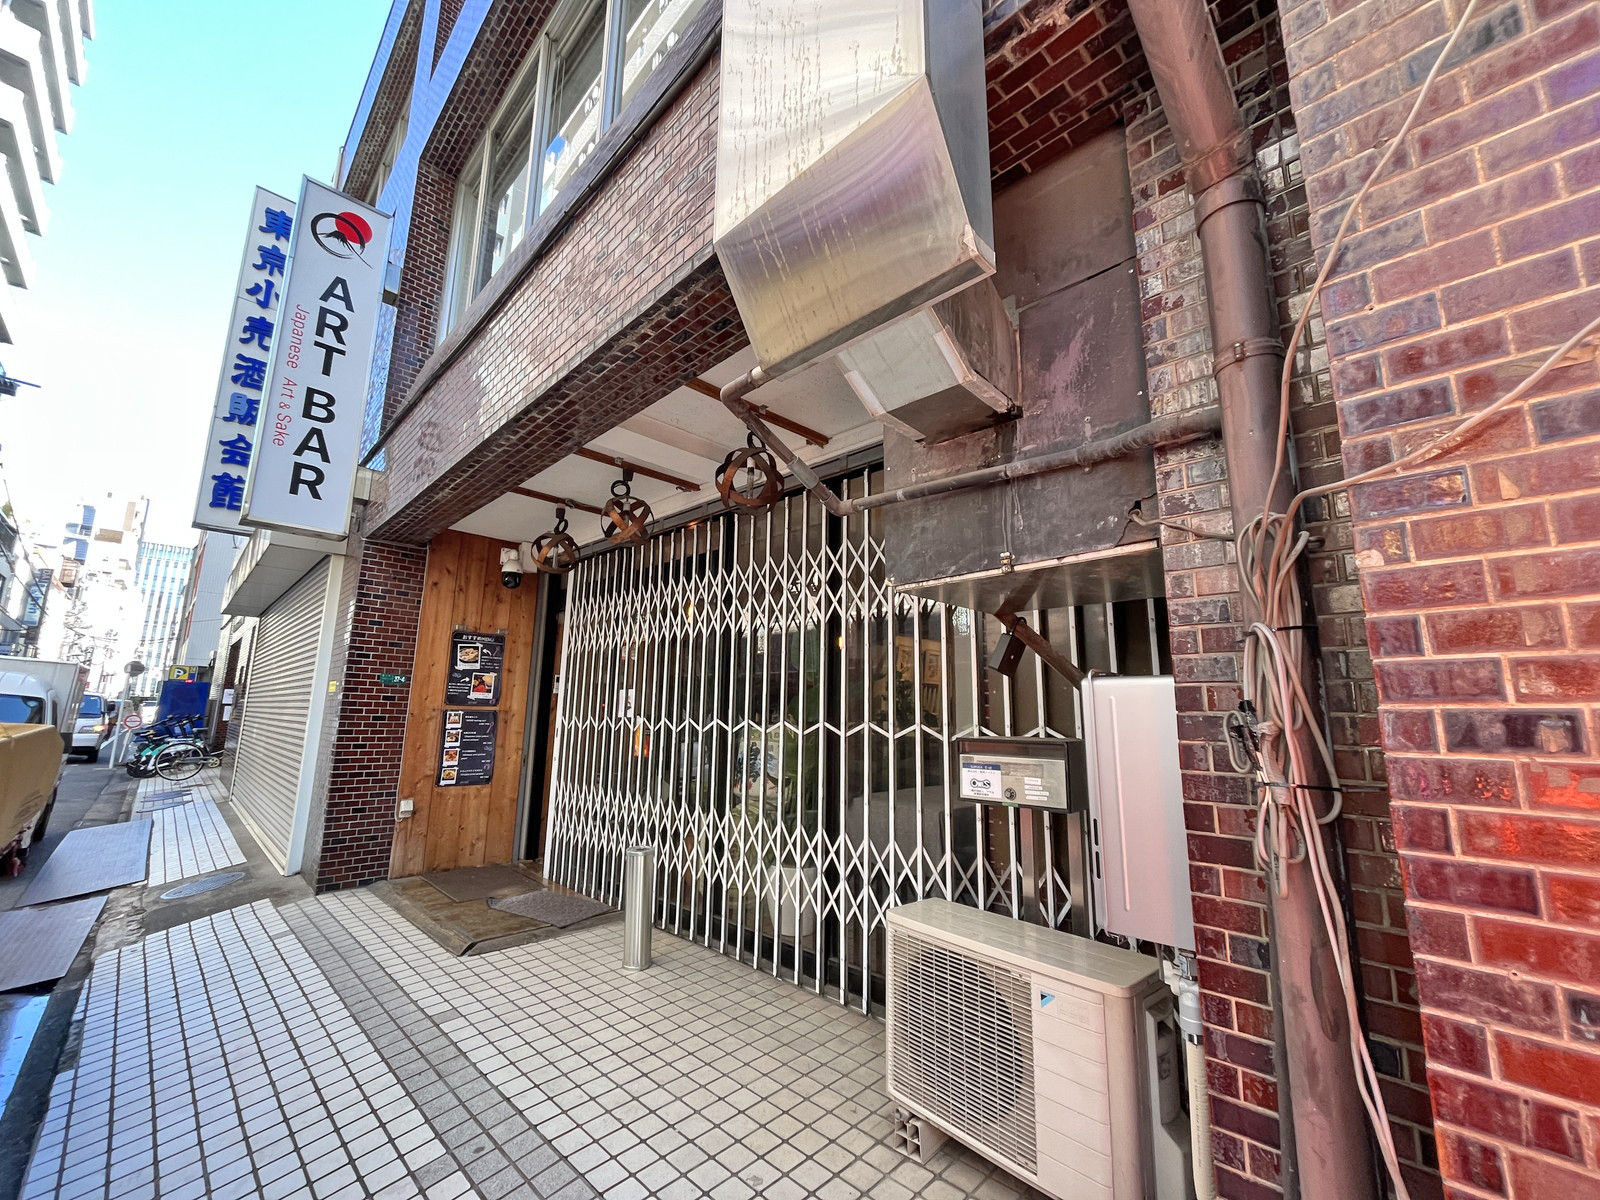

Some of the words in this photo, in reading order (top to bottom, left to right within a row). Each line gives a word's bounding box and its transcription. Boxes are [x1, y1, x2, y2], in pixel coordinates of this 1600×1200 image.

[286, 304, 311, 370] Japanese
[313, 276, 355, 377] ART
[280, 376, 299, 400] Art
[278, 402, 291, 413] &
[273, 414, 293, 448] Sake
[288, 386, 337, 500] BAR
[173, 667, 187, 679] P
